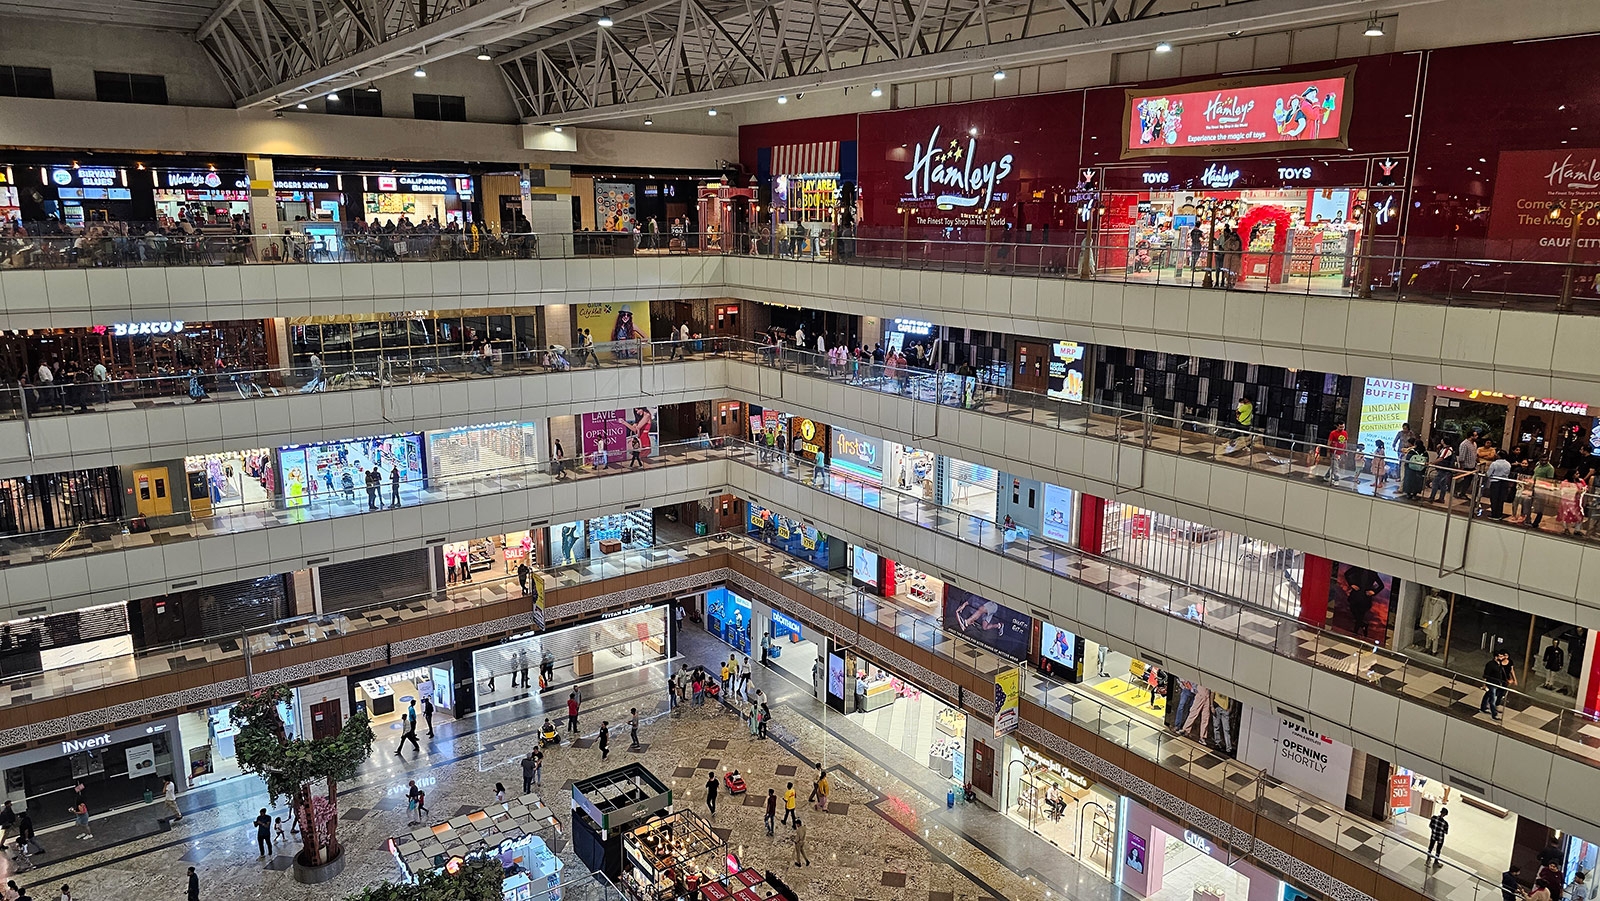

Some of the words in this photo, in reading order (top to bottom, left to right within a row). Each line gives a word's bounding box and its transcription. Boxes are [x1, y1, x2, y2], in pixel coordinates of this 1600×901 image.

[1203, 93, 1254, 122] Hamleys
[1188, 135, 1216, 143] Experience
[1228, 132, 1245, 142] magic
[1253, 131, 1266, 140] toys
[78, 169, 116, 178] BIRYANI
[905, 125, 1013, 212] Hamleys
[1278, 166, 1312, 180] TOYS
[82, 177, 114, 186] BLUES
[168, 172, 204, 187] Wendy's
[1142, 172, 1169, 185] TOYS
[1200, 163, 1240, 188] Hamleys
[817, 179, 837, 190] AREA
[1517, 199, 1552, 209] Come
[944, 218, 953, 226] Toy
[955, 218, 968, 226] Shop
[1518, 214, 1540, 224] The
[1366, 378, 1410, 391] LAVISH
[1366, 389, 1408, 400] BUFFET
[1369, 404, 1400, 412] INDIAN
[1533, 401, 1562, 412] BLACK
[1563, 406, 1587, 416] CAFE
[592, 411, 616, 420] LAVIE
[1367, 413, 1400, 421] CHINESE
[586, 427, 623, 438] OPENING
[505, 549, 524, 559] SALE
[377, 667, 429, 685] SAMSUNG
[62, 734, 111, 753] iNvent
[1283, 739, 1327, 763] OPENING
[1282, 748, 1326, 773] SHORTLY
[501, 833, 532, 854] Point
